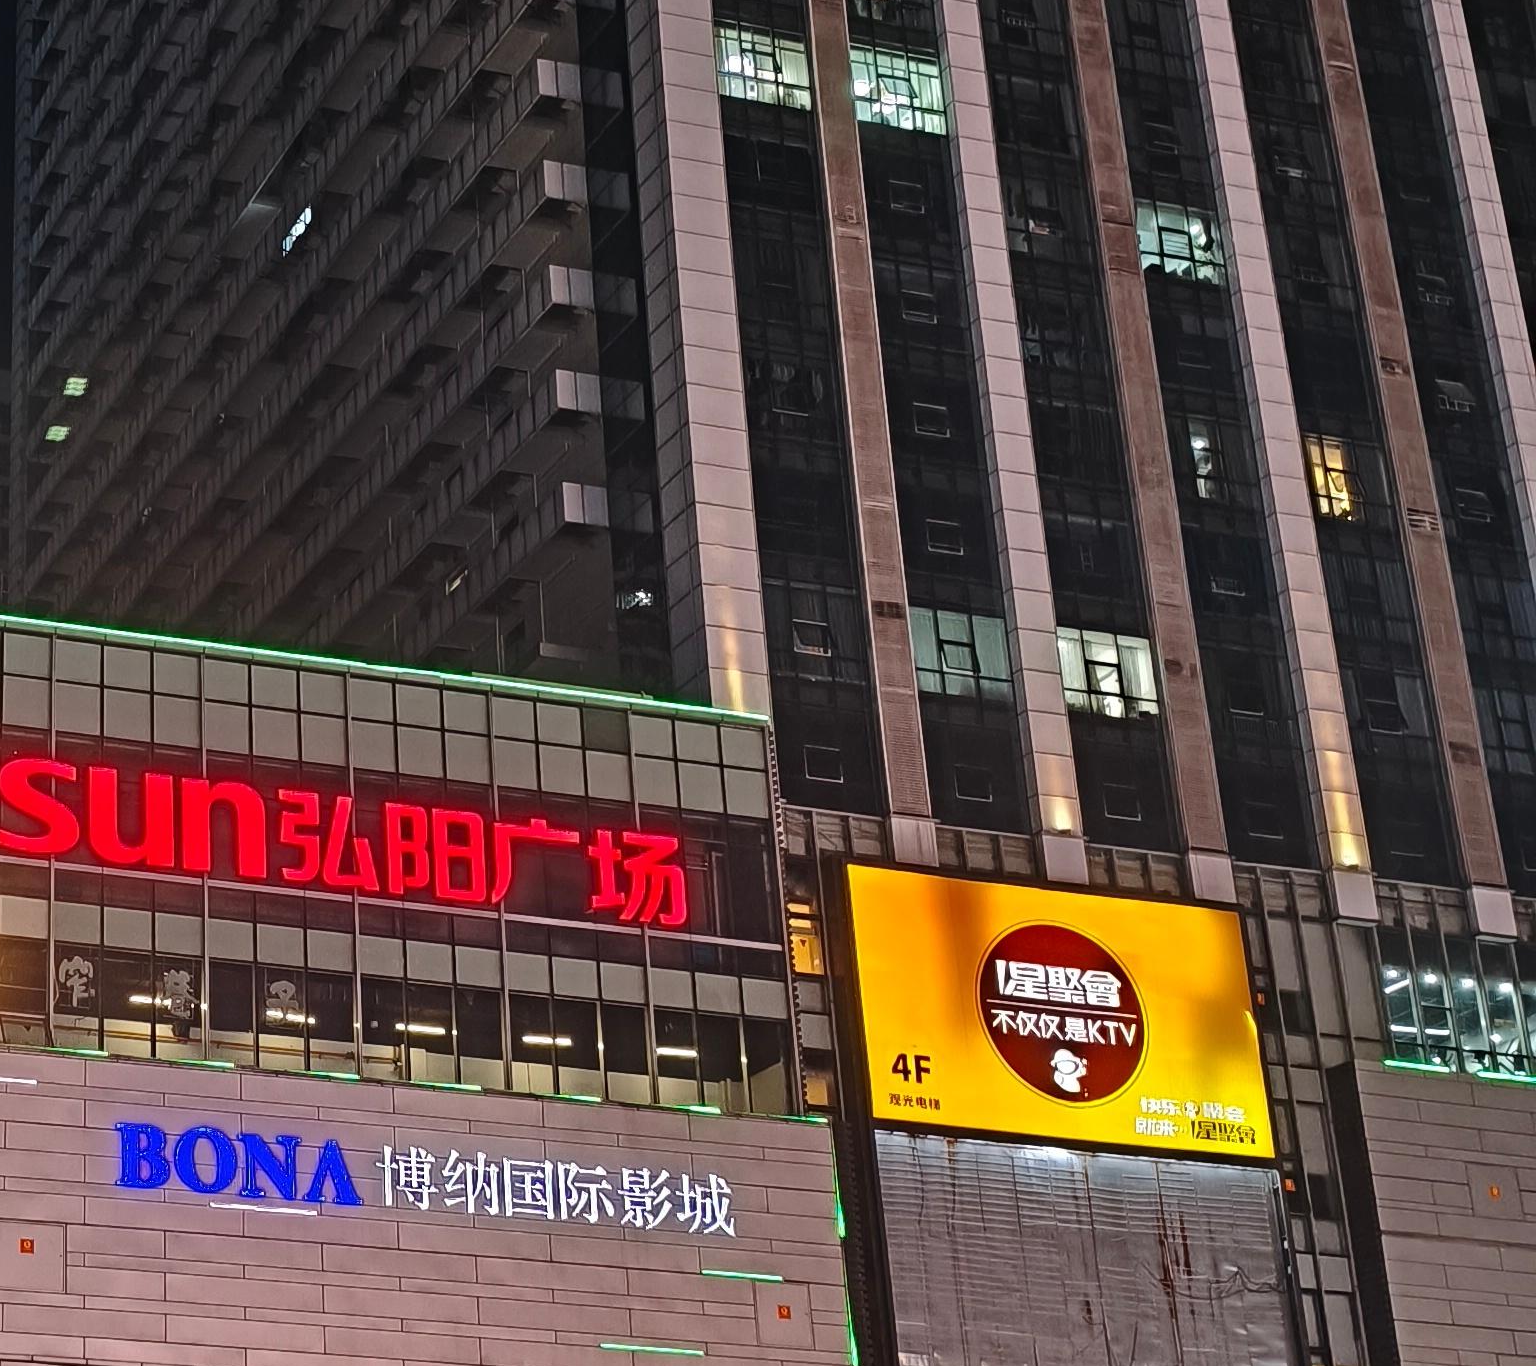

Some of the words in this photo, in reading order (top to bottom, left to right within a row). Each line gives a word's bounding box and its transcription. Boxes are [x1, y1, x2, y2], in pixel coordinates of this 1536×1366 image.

[277, 787, 687, 926] 弘阳广场
[891, 1053, 931, 1084] 4F
[115, 1122, 363, 1206] BONA
[375, 1144, 737, 1237] 博纳国际影城
